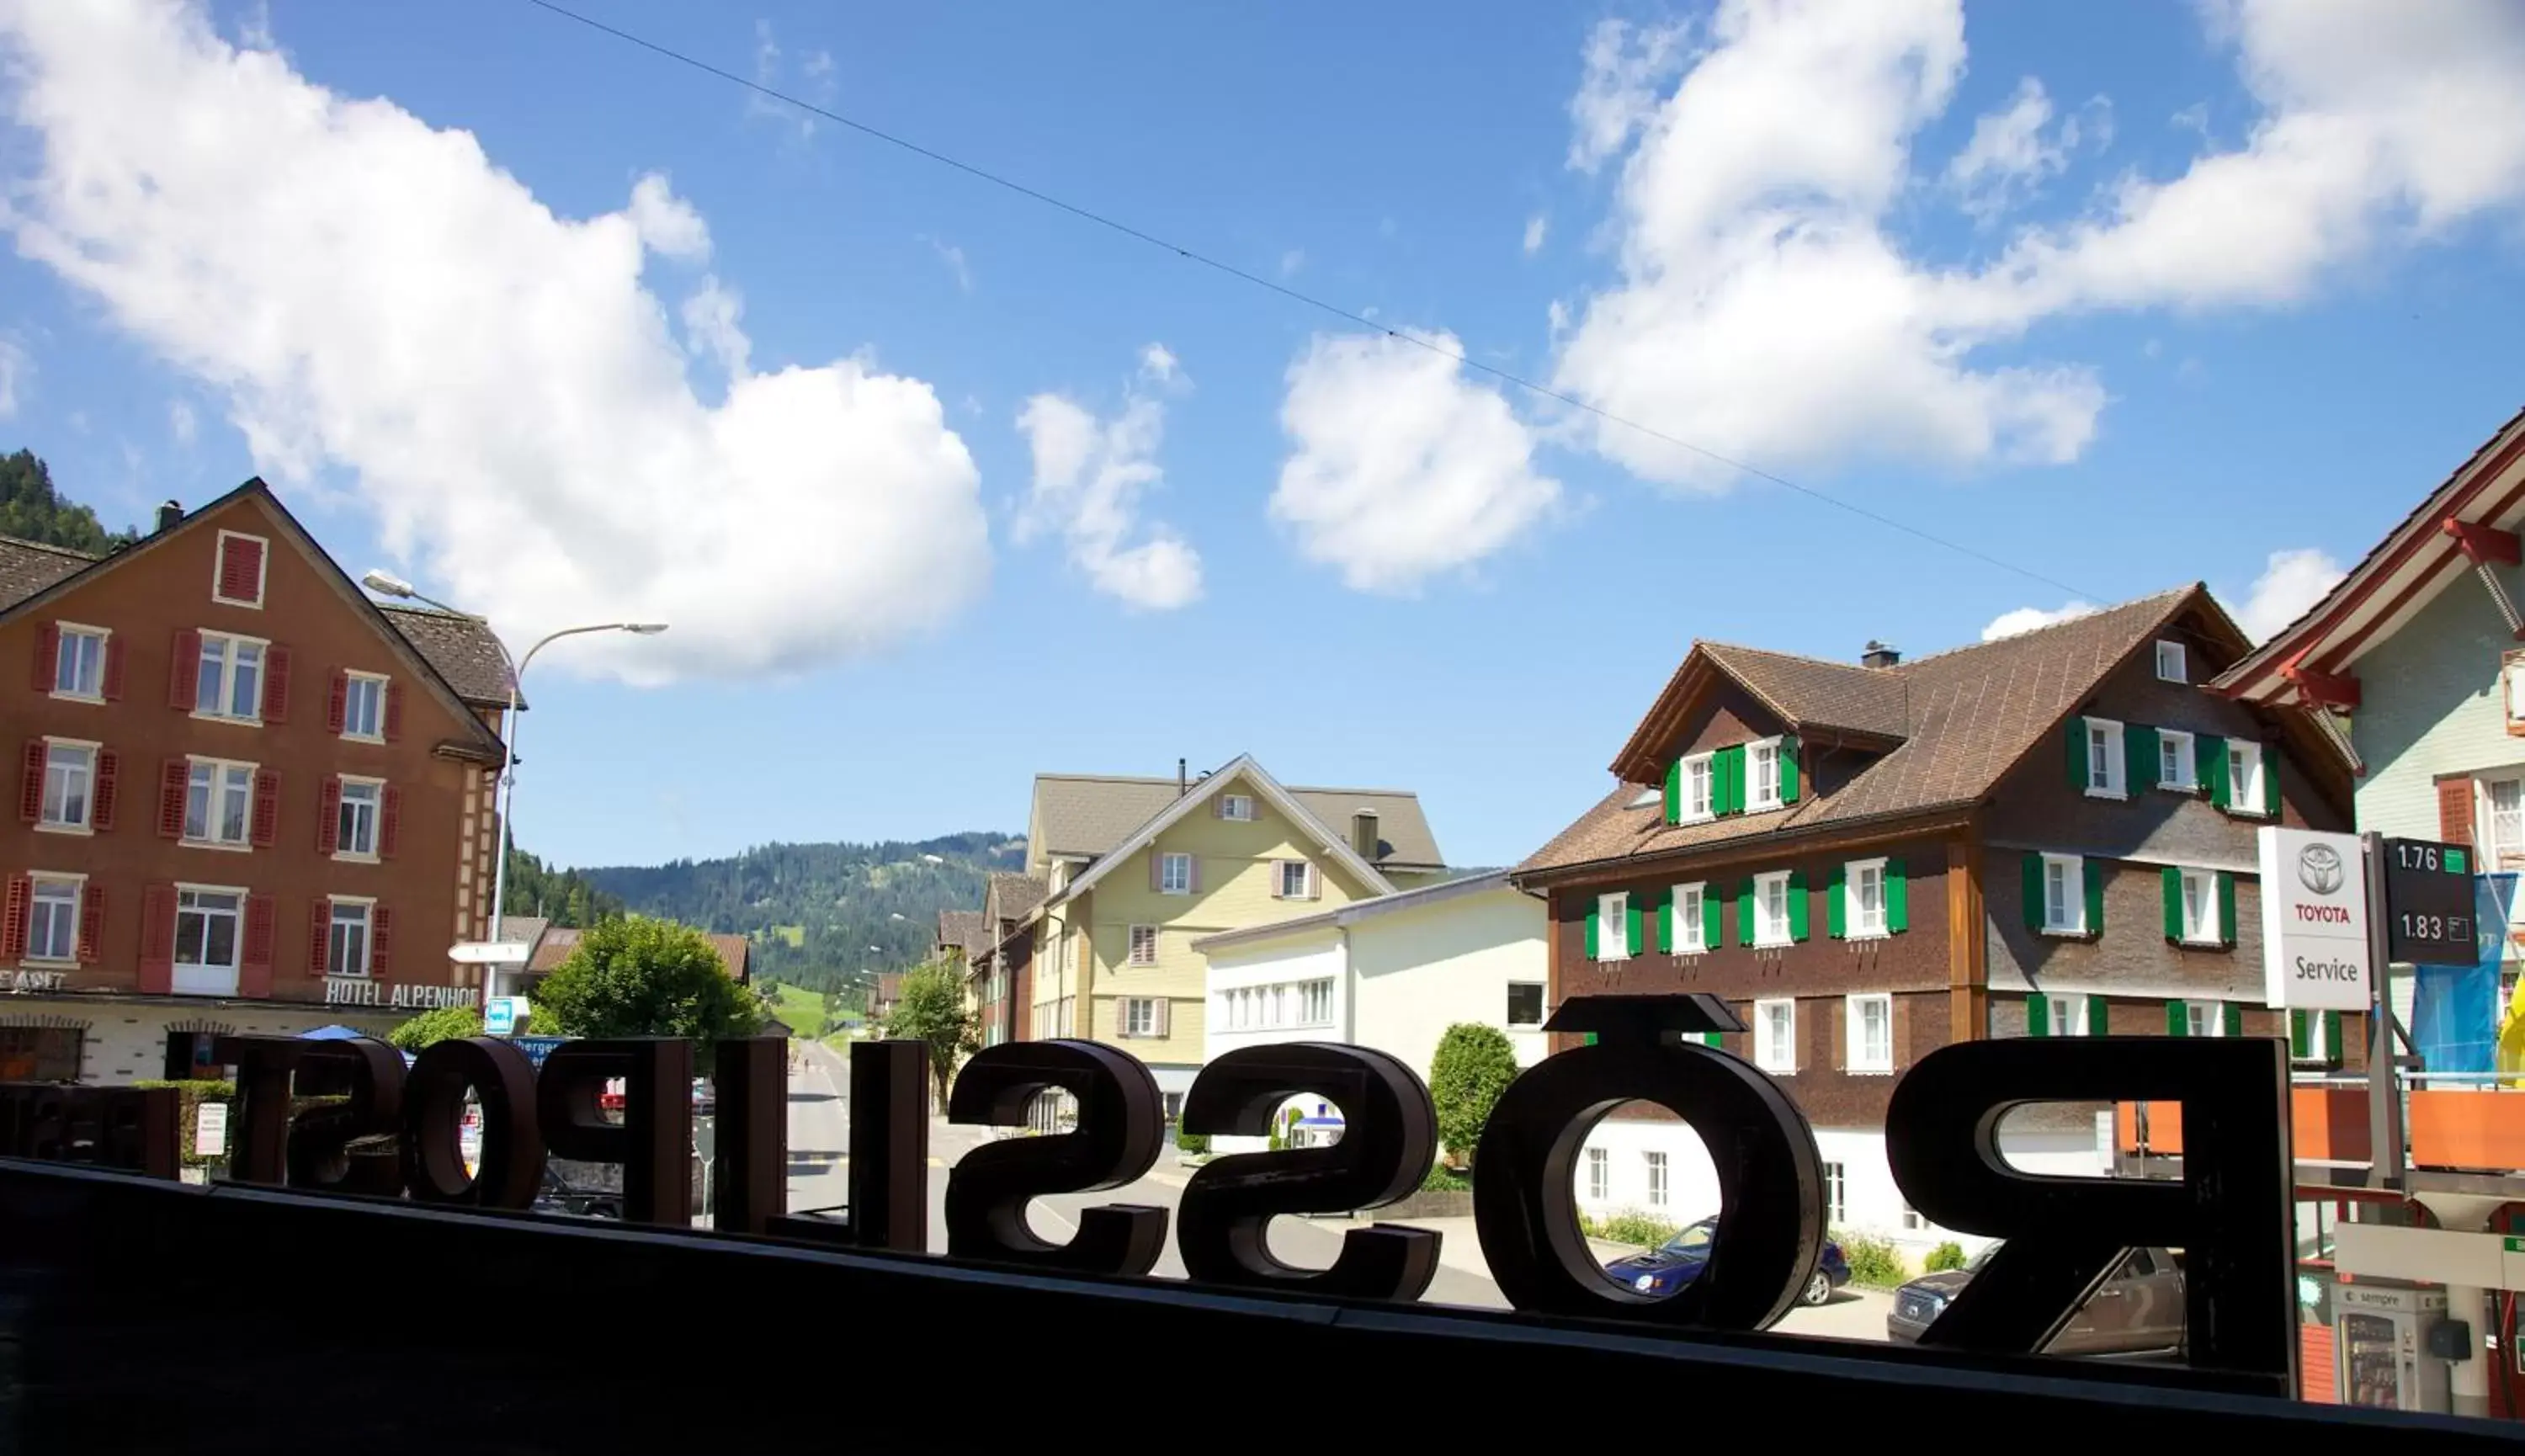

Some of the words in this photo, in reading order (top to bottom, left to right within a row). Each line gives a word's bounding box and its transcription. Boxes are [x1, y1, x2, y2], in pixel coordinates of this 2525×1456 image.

[2398, 844, 2437, 871] 1.76
[2295, 903, 2351, 924] TOYOTA
[2402, 913, 2442, 939] 1.83
[2296, 955, 2358, 981] Service
[326, 980, 380, 1005] HOTEL
